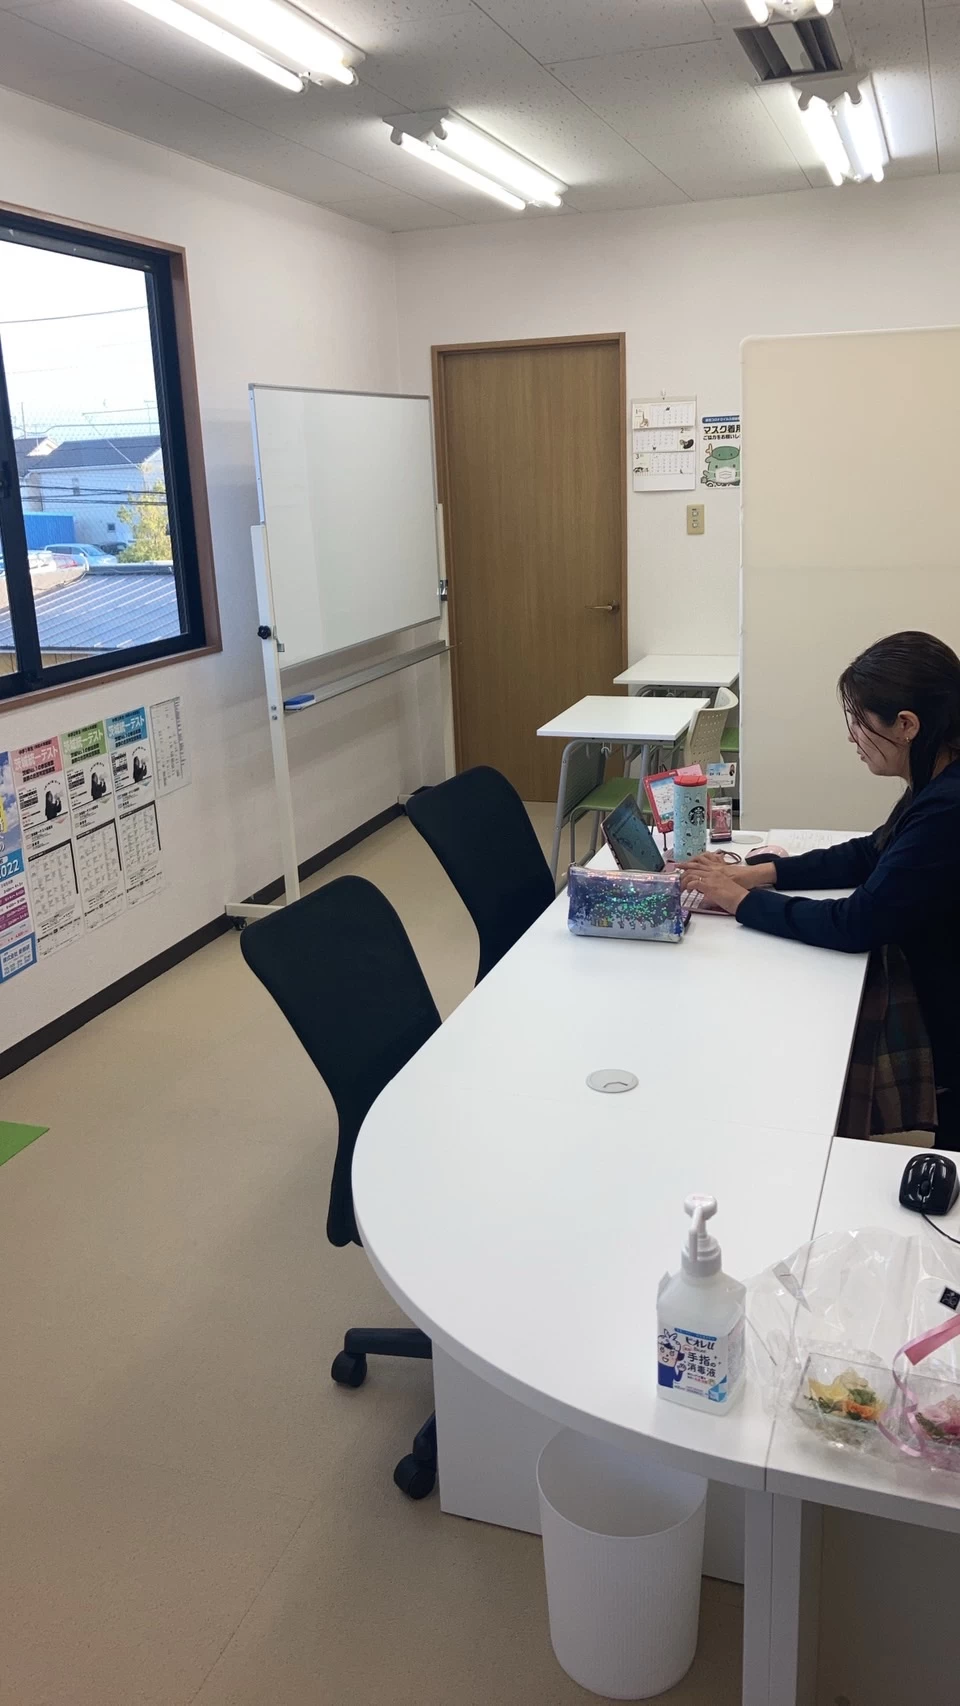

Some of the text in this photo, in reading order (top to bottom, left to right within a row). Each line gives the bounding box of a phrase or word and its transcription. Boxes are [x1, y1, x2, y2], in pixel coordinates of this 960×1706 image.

[0, 859, 20, 878] 022
[687, 1352, 716, 1367] 手指の
[687, 1362, 716, 1378] 消毒液
